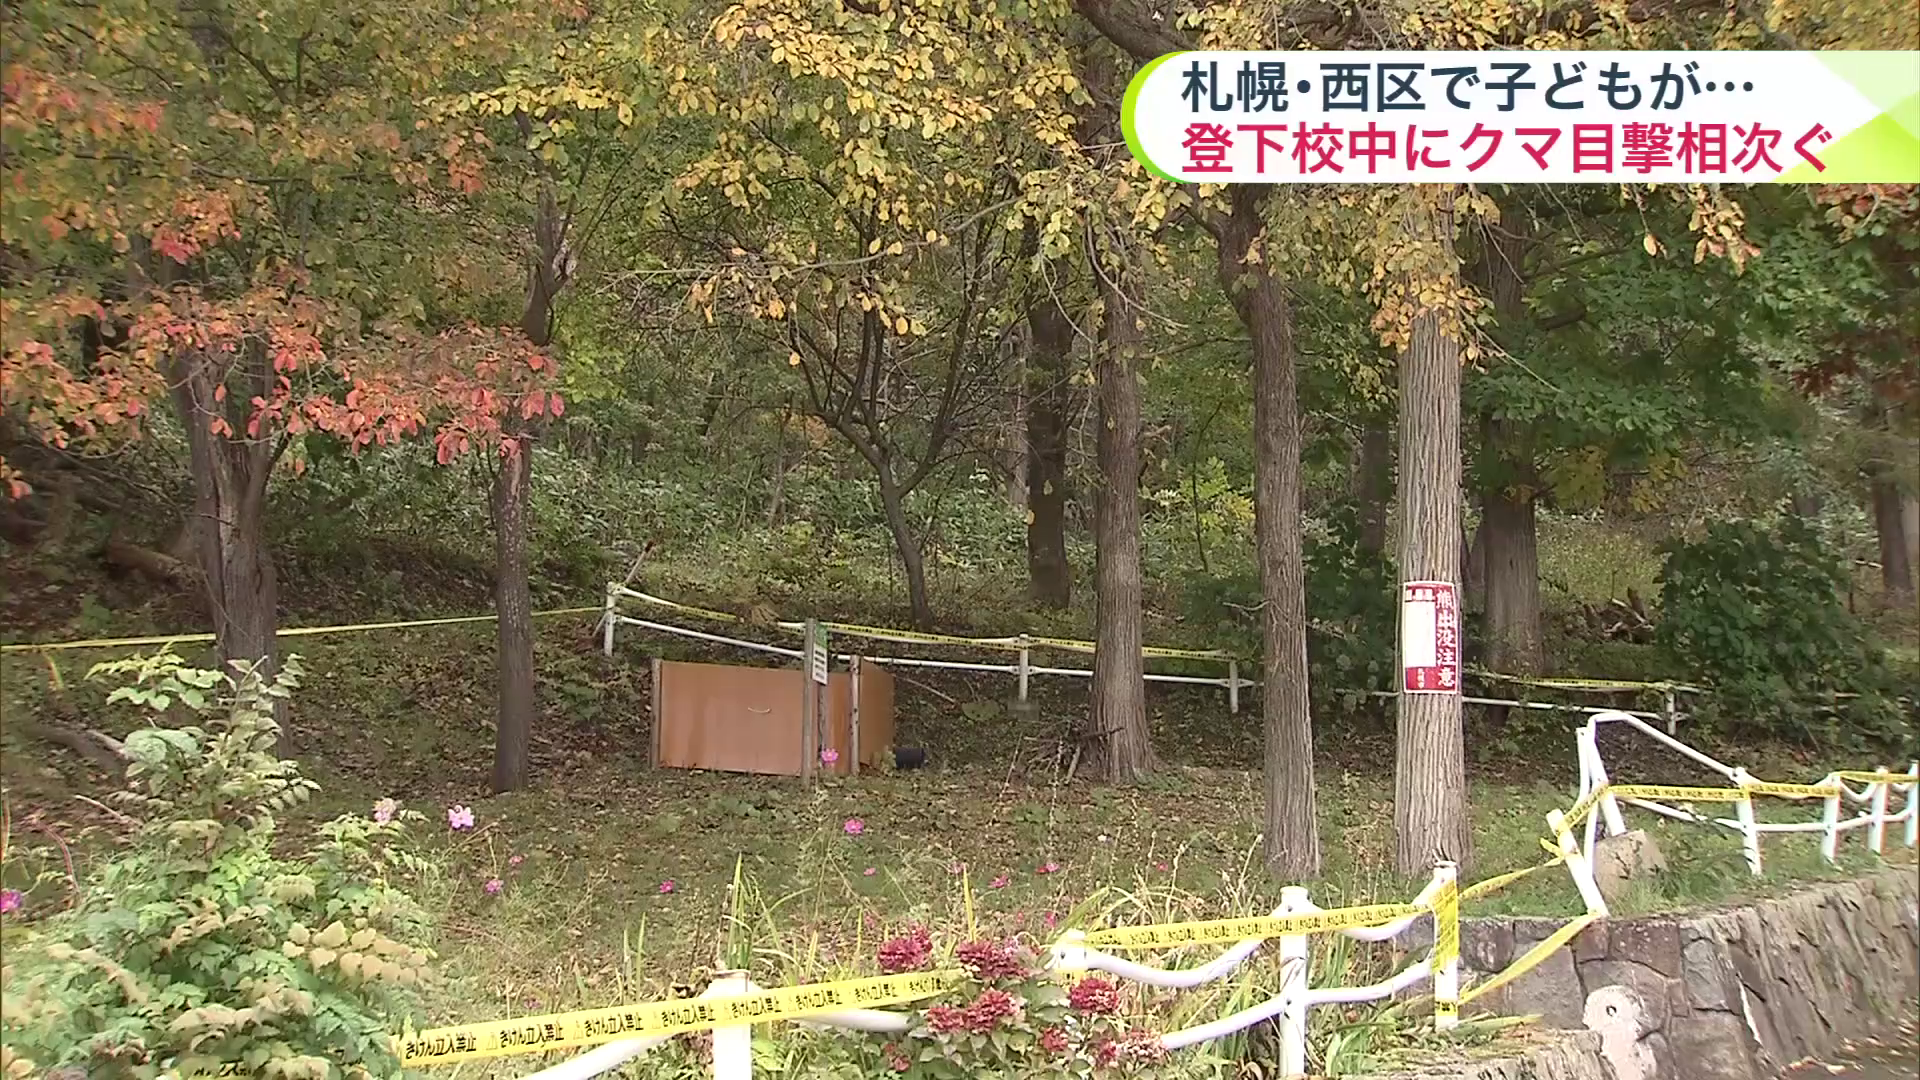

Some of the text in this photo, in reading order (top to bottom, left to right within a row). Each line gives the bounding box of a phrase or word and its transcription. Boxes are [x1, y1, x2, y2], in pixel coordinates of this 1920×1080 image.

[1436, 588, 1456, 688] 熊出没注意
[405, 1033, 477, 1060] きけん立入禁止
[499, 1023, 565, 1048] きけん立入禁止
[584, 1013, 644, 1037] きけん立入禁止
[661, 1004, 716, 1027] きけん立入禁止
